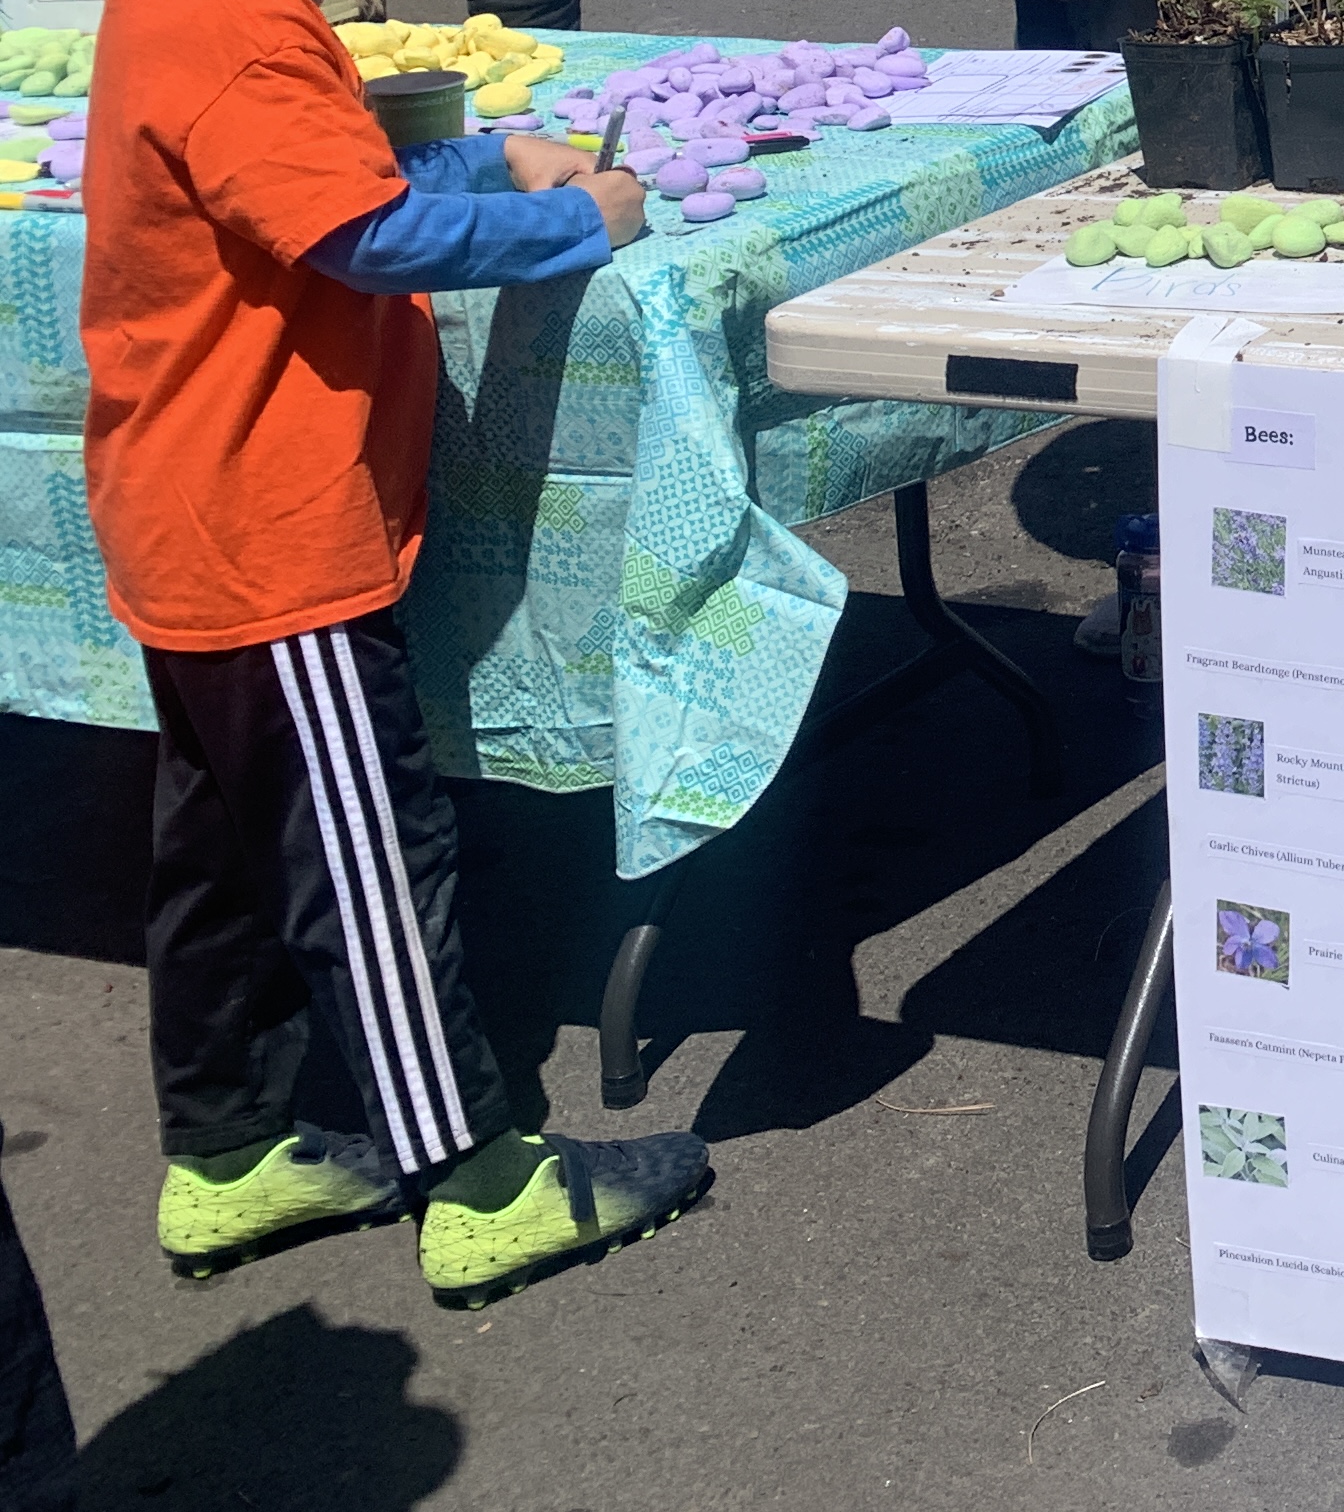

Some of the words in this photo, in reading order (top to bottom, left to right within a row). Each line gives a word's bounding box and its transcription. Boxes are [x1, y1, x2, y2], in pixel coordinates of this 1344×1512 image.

[1091, 266, 1241, 297] Birds
[1244, 425, 1294, 446] Bees:
[1185, 652, 1229, 669] Fragrant
[1231, 659, 1290, 679] Beardtonge
[1276, 752, 1309, 769] Rocky
[1275, 772, 1320, 790] Strictus)
[1208, 839, 1240, 854] Garlic
[1240, 844, 1275, 860] Chives
[1275, 849, 1314, 866] (Allium
[1308, 945, 1343, 961] Prairie
[1208, 1031, 1254, 1048] Faassen's
[1254, 1039, 1296, 1056] Catmint
[1297, 1047, 1337, 1063] (Nepeta
[1218, 1248, 1274, 1266] Pincushion
[1275, 1257, 1309, 1272] Lucida
